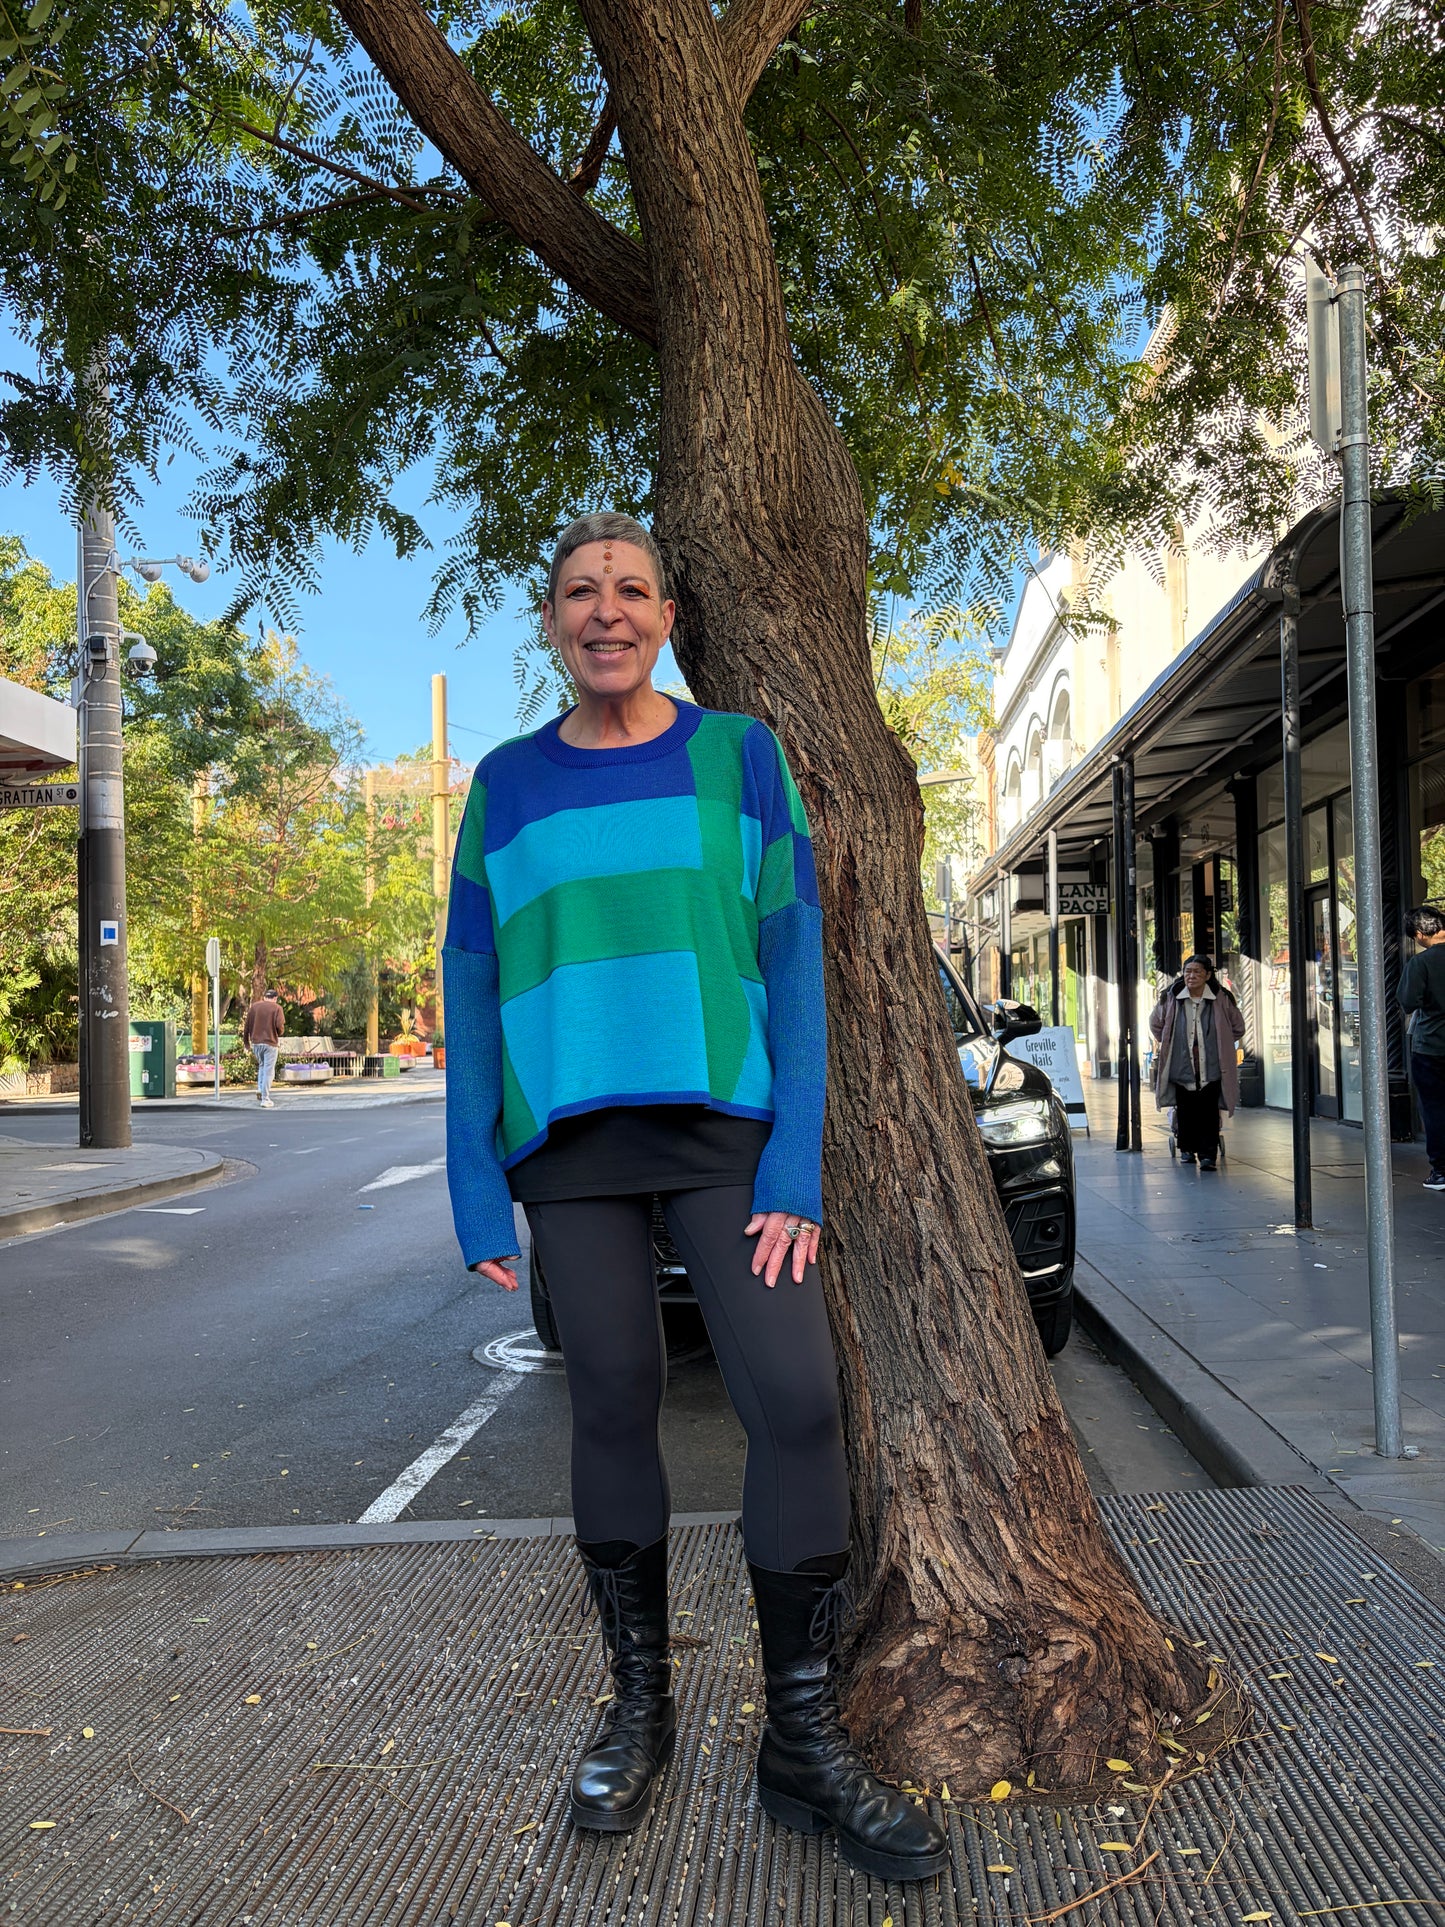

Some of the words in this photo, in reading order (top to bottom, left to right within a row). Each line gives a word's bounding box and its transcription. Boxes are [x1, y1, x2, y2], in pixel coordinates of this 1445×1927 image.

[56, 788, 64, 797] ST
[1047, 885, 1107, 898] LANT
[1047, 900, 1107, 913] PACE
[1025, 1038, 1057, 1053] Greville
[1031, 1053, 1053, 1067] Nails
